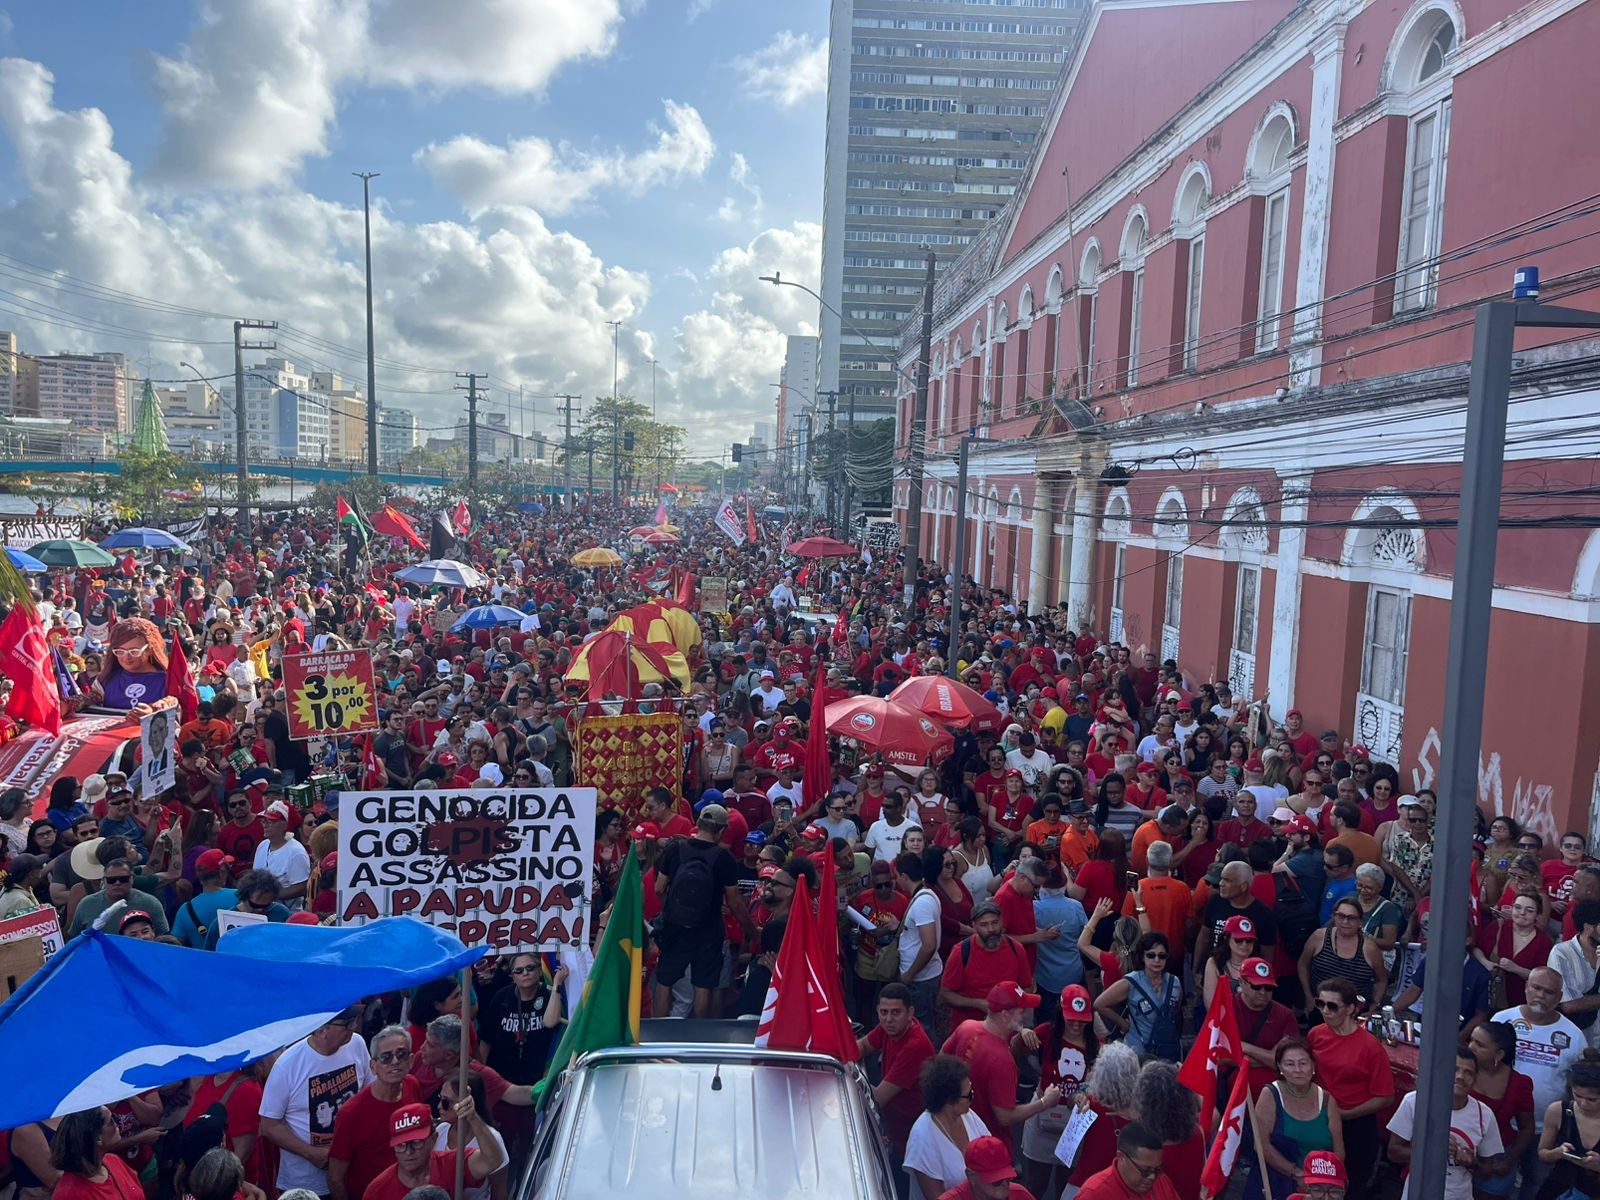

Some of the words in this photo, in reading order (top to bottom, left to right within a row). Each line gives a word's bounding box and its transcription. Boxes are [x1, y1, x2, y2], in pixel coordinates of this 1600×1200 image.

[300, 654, 341, 667] BARRACA
[343, 653, 356, 663] DA
[304, 674, 329, 700] 3
[332, 685, 356, 699] por
[888, 750, 918, 761] AMSTEL
[355, 793, 576, 824] GENOCIDA
[350, 824, 581, 858] GOLPISTA
[349, 856, 583, 888] ASSASSINO
[343, 891, 379, 921] A
[392, 884, 574, 917] PAPUDA
[435, 916, 584, 949] PERA!
[1515, 1040, 1557, 1052] CSP
[310, 1067, 356, 1098] PARALAMAS
[395, 1116, 418, 1130] LULA
